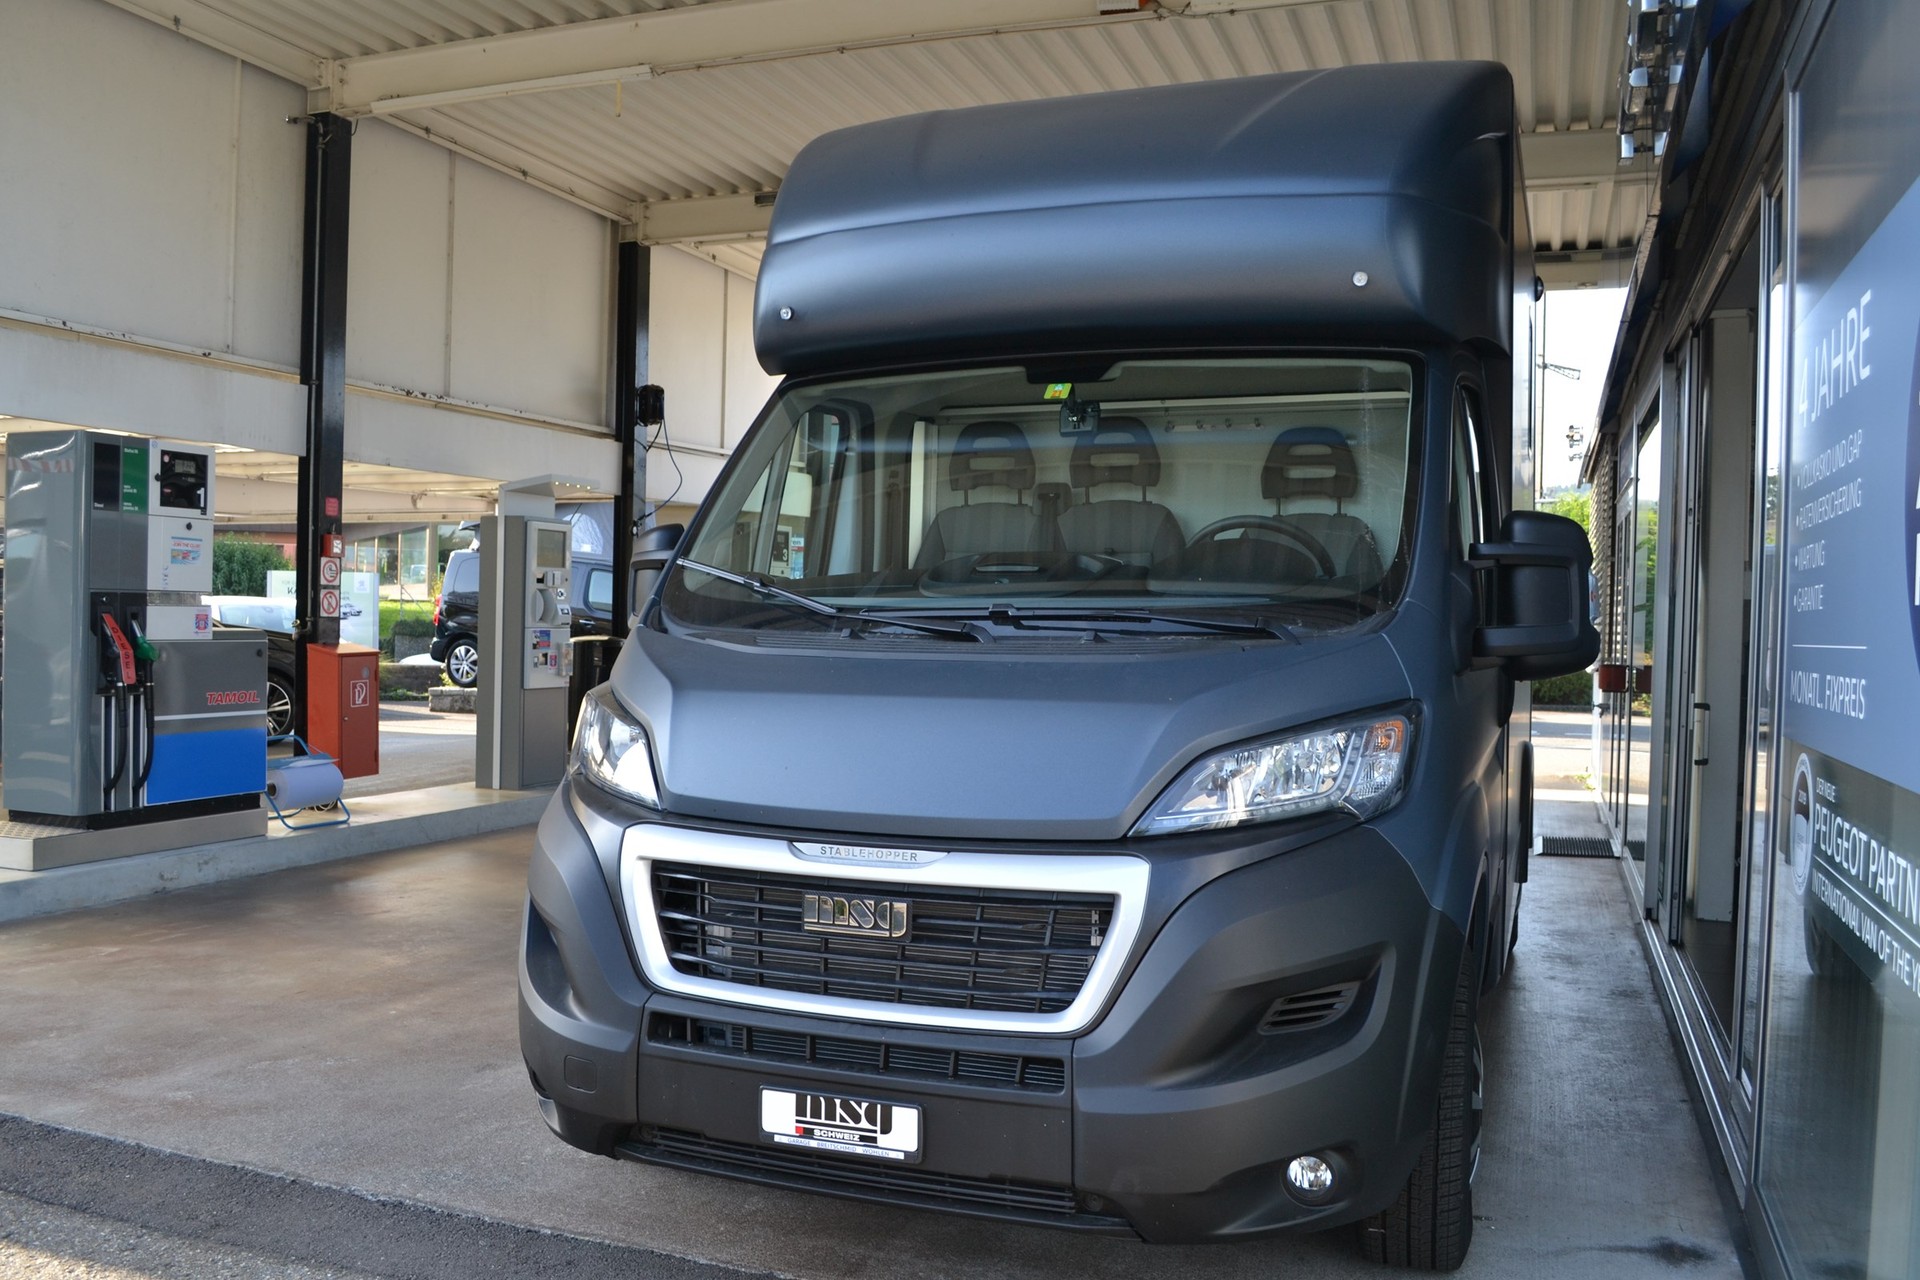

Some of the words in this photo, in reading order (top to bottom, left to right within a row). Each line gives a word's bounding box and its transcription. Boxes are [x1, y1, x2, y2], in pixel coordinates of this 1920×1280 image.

[1799, 357, 1807, 428] 4
[1811, 289, 1871, 423] JAHRE
[1848, 429, 1862, 463] GAP
[196, 487, 205, 508] 1
[782, 549, 788, 561] 3
[1798, 540, 1825, 571] WARTUNG
[1797, 584, 1824, 612] GARANTIE
[111, 626, 131, 680] DIESEL
[206, 690, 260, 705] TAMOIL
[1790, 670, 1823, 709] MONATL.
[1825, 674, 1866, 720] FIXPREIS
[820, 845, 918, 862] STABLEHOPPER
[1813, 802, 1867, 881] PEUGEOT
[1812, 867, 1860, 937] INTERNATIONAL
[1861, 912, 1878, 952] VAN
[1878, 929, 1891, 964] OF
[1892, 941, 1911, 986] THE
[787, 1137, 811, 1146] GARAGE
[816, 1141, 857, 1152] BREITSCHMID
[813, 1128, 860, 1142] SCHWEIZ
